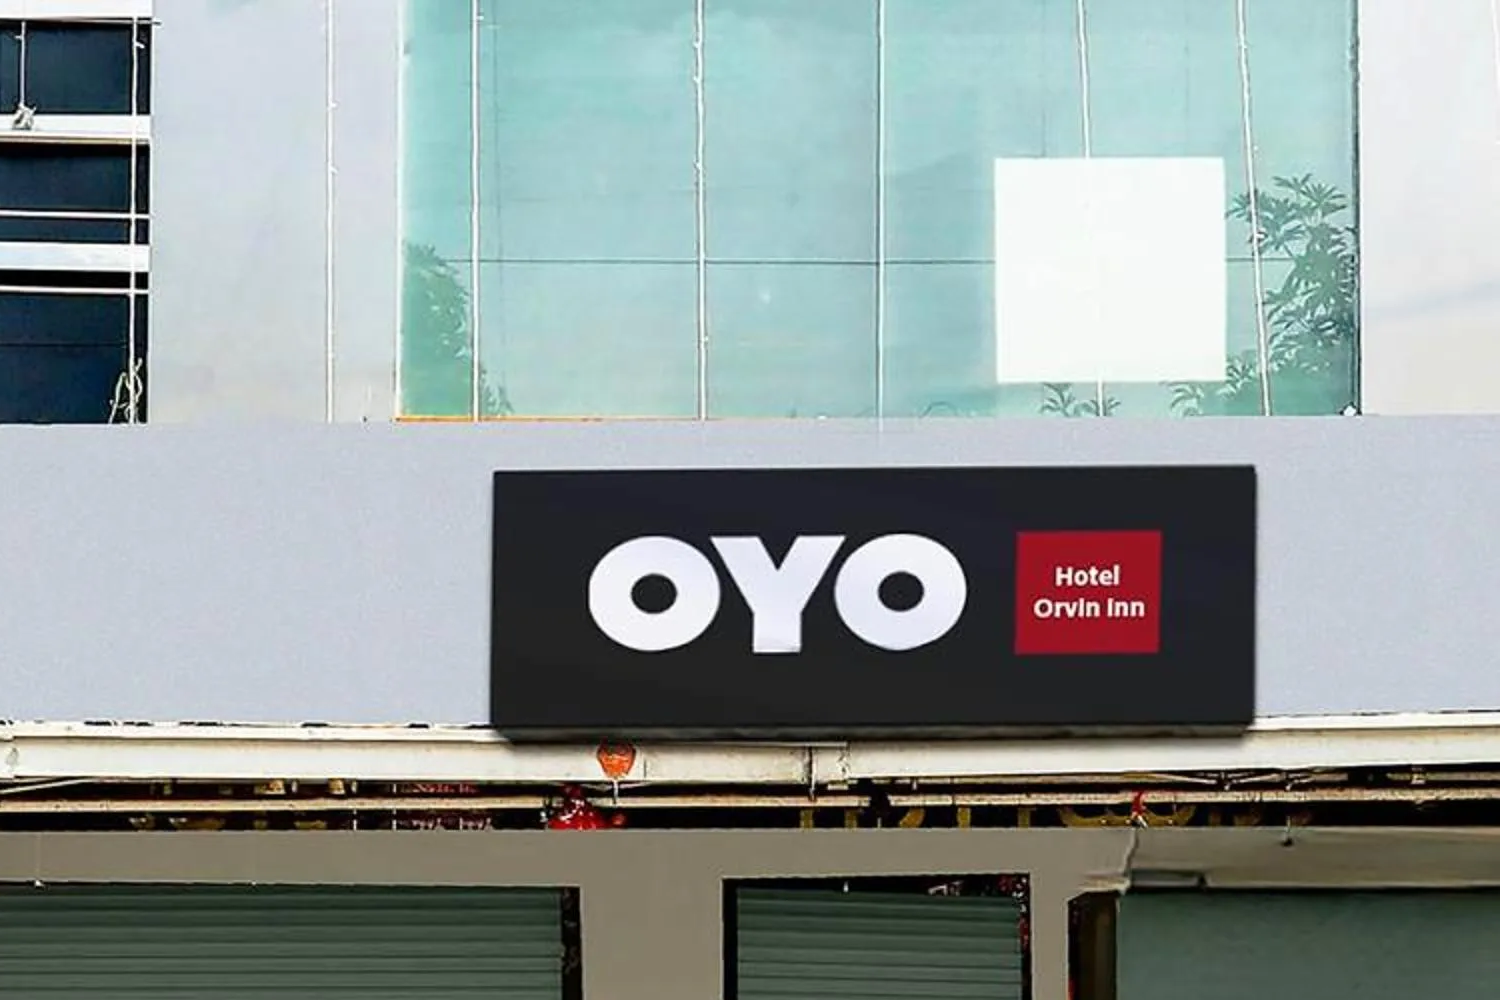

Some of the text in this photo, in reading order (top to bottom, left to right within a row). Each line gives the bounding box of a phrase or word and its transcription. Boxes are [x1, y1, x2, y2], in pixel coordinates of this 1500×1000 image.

[1055, 565, 1120, 587] Hotel
[589, 533, 967, 653] OYO
[1034, 596, 1145, 619] Orvin Inn
